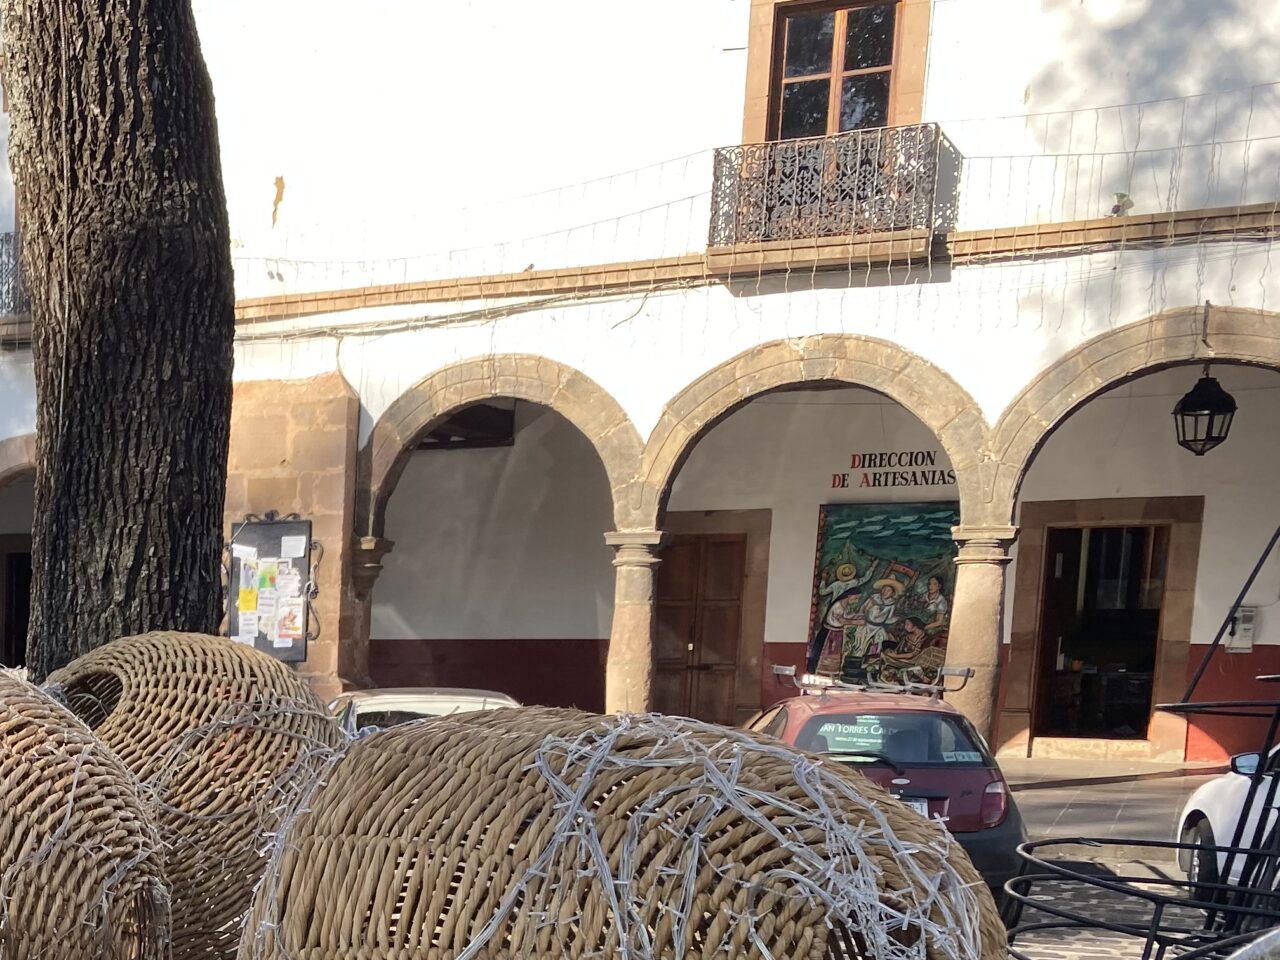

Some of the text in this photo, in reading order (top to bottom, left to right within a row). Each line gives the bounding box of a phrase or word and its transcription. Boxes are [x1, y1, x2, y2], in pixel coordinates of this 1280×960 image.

[850, 450, 937, 469] DIRECCION
[831, 469, 957, 489] DE ARTESANIAS
[836, 723, 868, 735] TORRES
